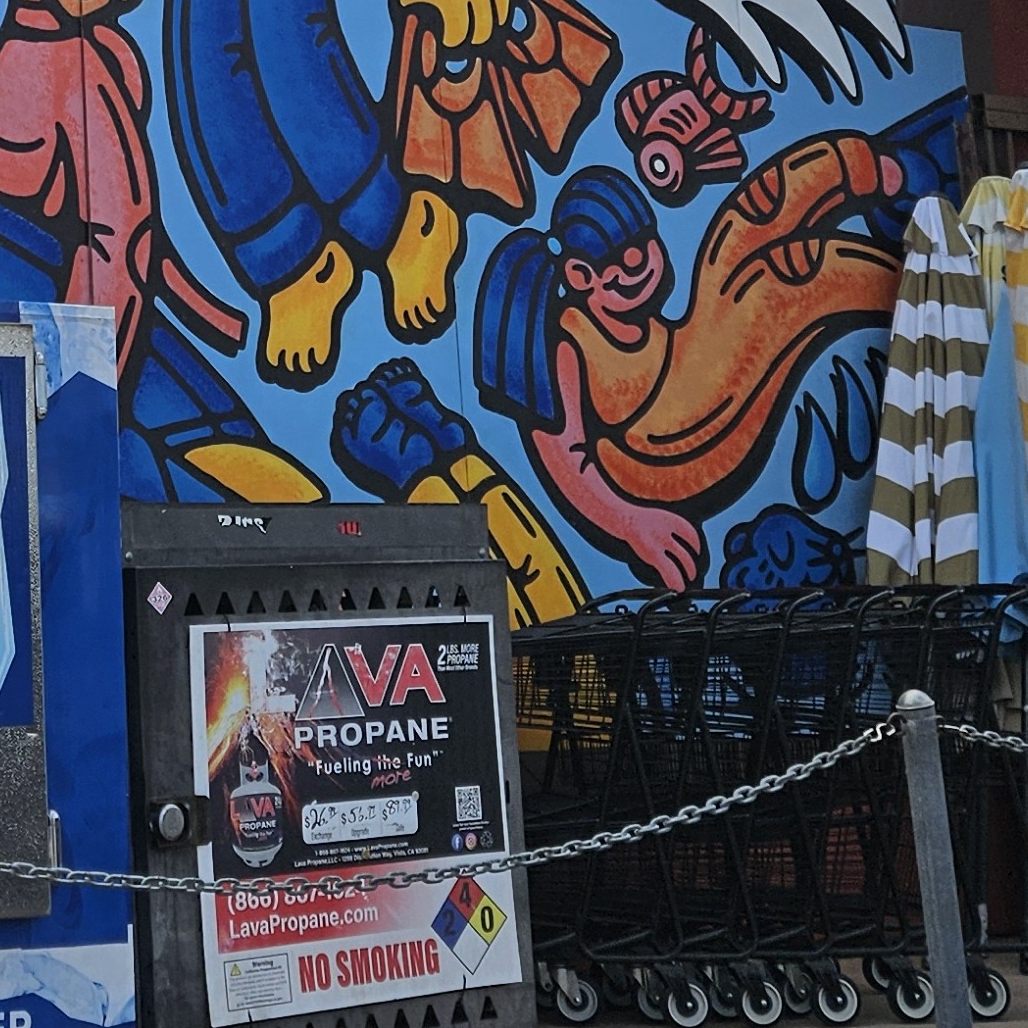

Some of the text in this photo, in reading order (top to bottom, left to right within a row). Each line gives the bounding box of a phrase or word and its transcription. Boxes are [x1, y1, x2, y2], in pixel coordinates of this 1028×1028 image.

[437, 644, 447, 665] 2
[447, 653, 479, 664] PROPANE
[294, 717, 450, 750] PROPANE
[377, 754, 401, 770] the
[459, 881, 472, 908] 4
[229, 906, 379, 940] LavaPropane.com
[444, 905, 495, 937] 2 0
[298, 952, 332, 993] NO
[335, 938, 441, 988] SMOKING
